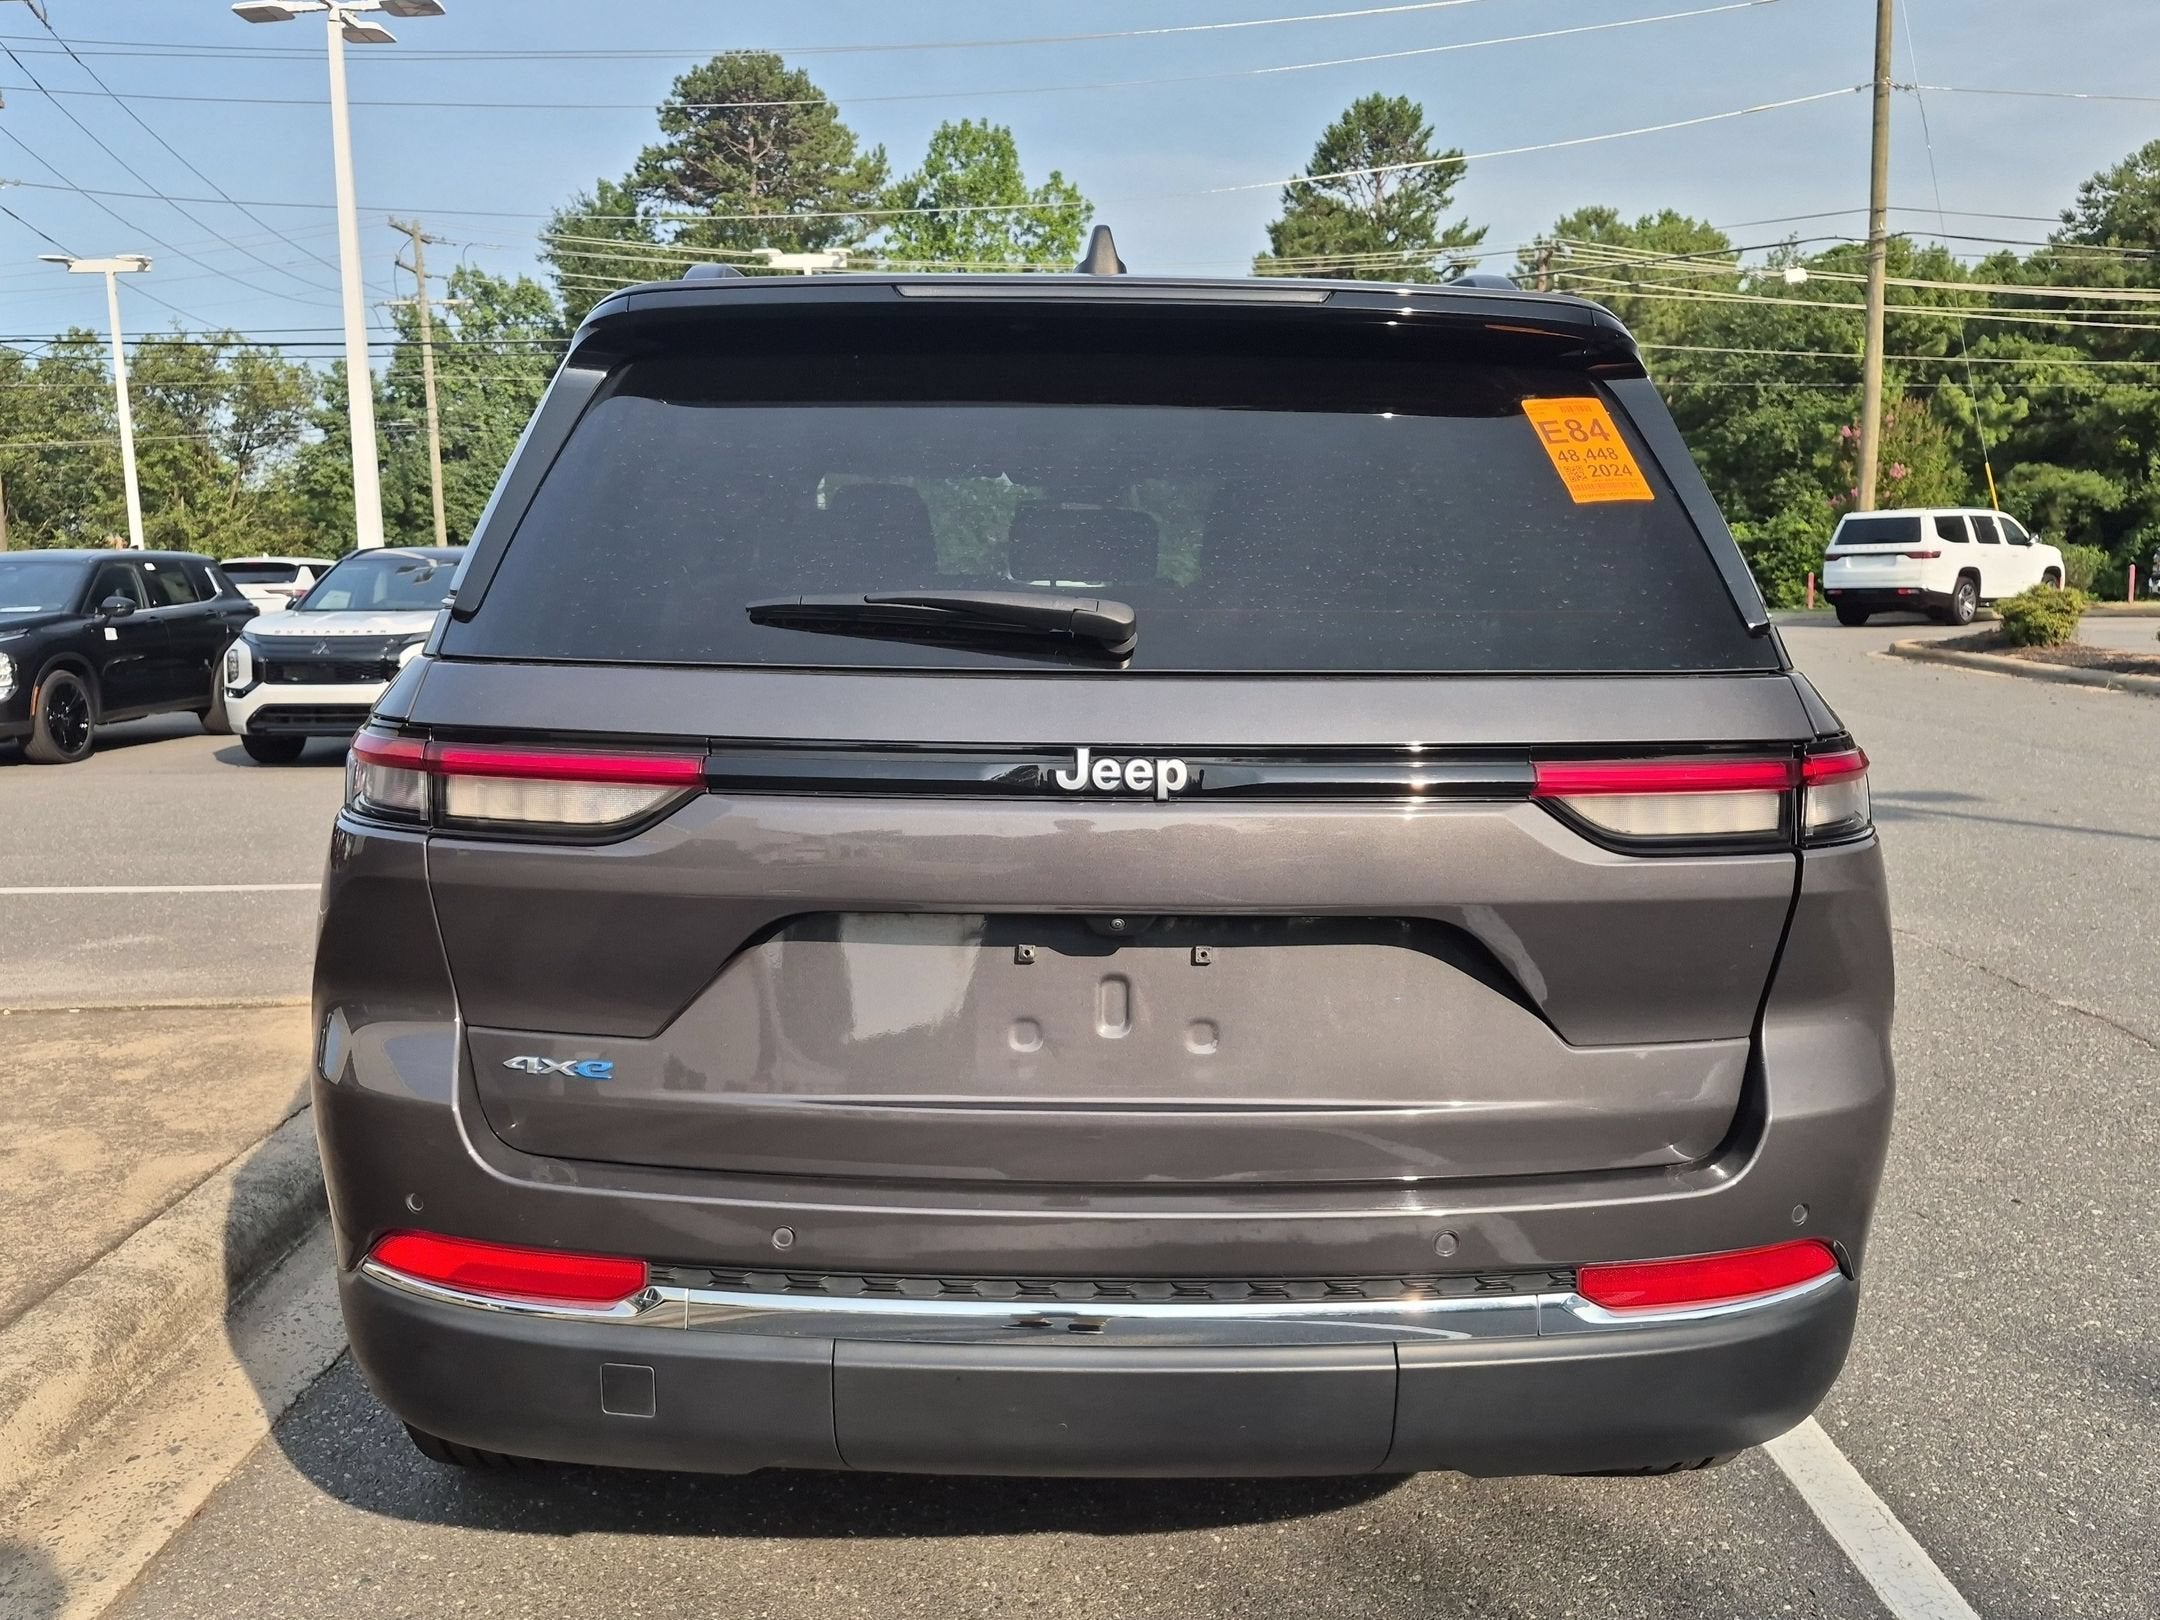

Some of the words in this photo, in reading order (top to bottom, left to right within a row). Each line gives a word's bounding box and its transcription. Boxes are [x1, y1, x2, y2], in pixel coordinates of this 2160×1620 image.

[1537, 418, 1610, 444] E84
[1588, 463, 1632, 477] 2024
[1056, 748, 1187, 800] Jeep
